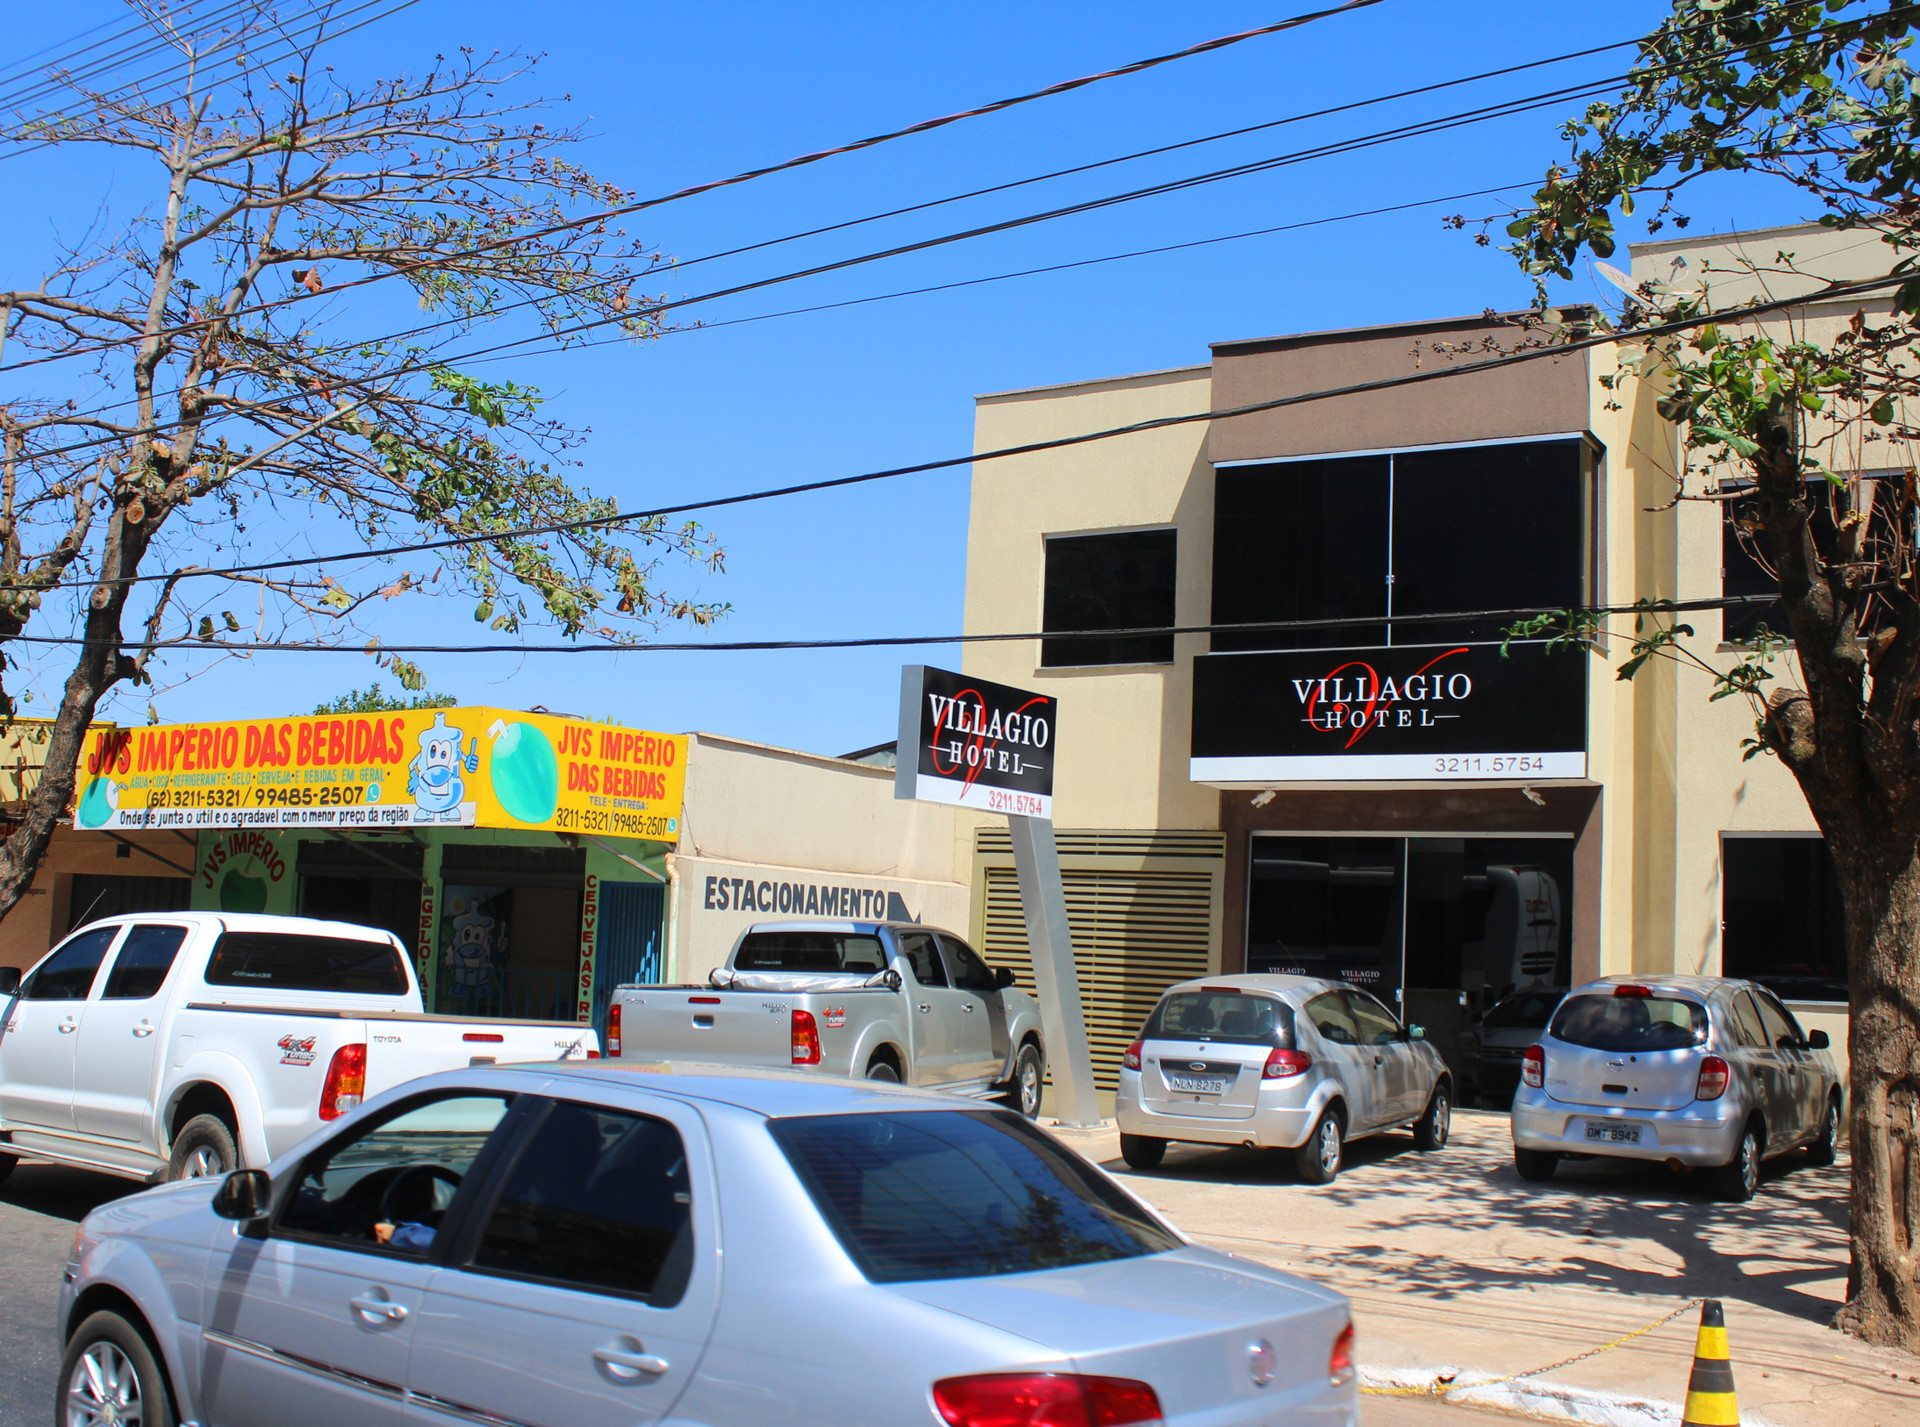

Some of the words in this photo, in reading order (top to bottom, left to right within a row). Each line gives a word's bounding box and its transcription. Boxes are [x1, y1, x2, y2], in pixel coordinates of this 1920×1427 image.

[1291, 673, 1473, 704] VILLAGIO
[928, 693, 1049, 749] VILLAGIO
[1324, 708, 1436, 729] HOTEL
[88, 731, 132, 775] JVS
[137, 724, 239, 772] IMPÉRIO
[243, 723, 293, 768] DAS
[296, 717, 405, 766] BEBIDAS
[557, 725, 593, 757] JVS
[599, 731, 675, 768] IMPÉRIO
[948, 740, 1024, 775] HOTEL
[173, 772, 227, 788] REFRIGERANTE
[231, 771, 251, 785] GELO
[256, 770, 291, 785] CERVEJA
[304, 768, 338, 783] BEBIDAS
[341, 768, 355, 782] EM
[359, 767, 385, 782] GERAL
[1434, 756, 1544, 773] 3211.5754
[567, 761, 600, 793] DAS
[602, 766, 666, 801] BEBIDAS
[146, 788, 171, 808] (62)
[173, 788, 240, 807] 3211-5321
[255, 786, 363, 806] 99485-2507
[589, 796, 607, 807] TELE
[988, 789, 1043, 815] 3211.5754
[120, 810, 142, 825] Onde
[145, 812, 156, 825] se
[157, 809, 184, 828] junta
[187, 812, 193, 824] o
[215, 811, 221, 824] e
[222, 812, 229, 824] o
[281, 810, 300, 823] com
[301, 810, 307, 822] o
[309, 809, 336, 822] menor
[339, 809, 366, 826] preço
[368, 807, 378, 822] da
[381, 806, 409, 825] região
[202, 843, 227, 889] JVS
[228, 829, 286, 882] IMPÉRIO
[704, 876, 886, 919] ESTACIONAMENTO
[418, 898, 434, 960] GELO
[580, 875, 598, 989] CERVEJAS
[1340, 970, 1380, 978] VILLAGIO
[373, 1035, 402, 1043] TOYOTA
